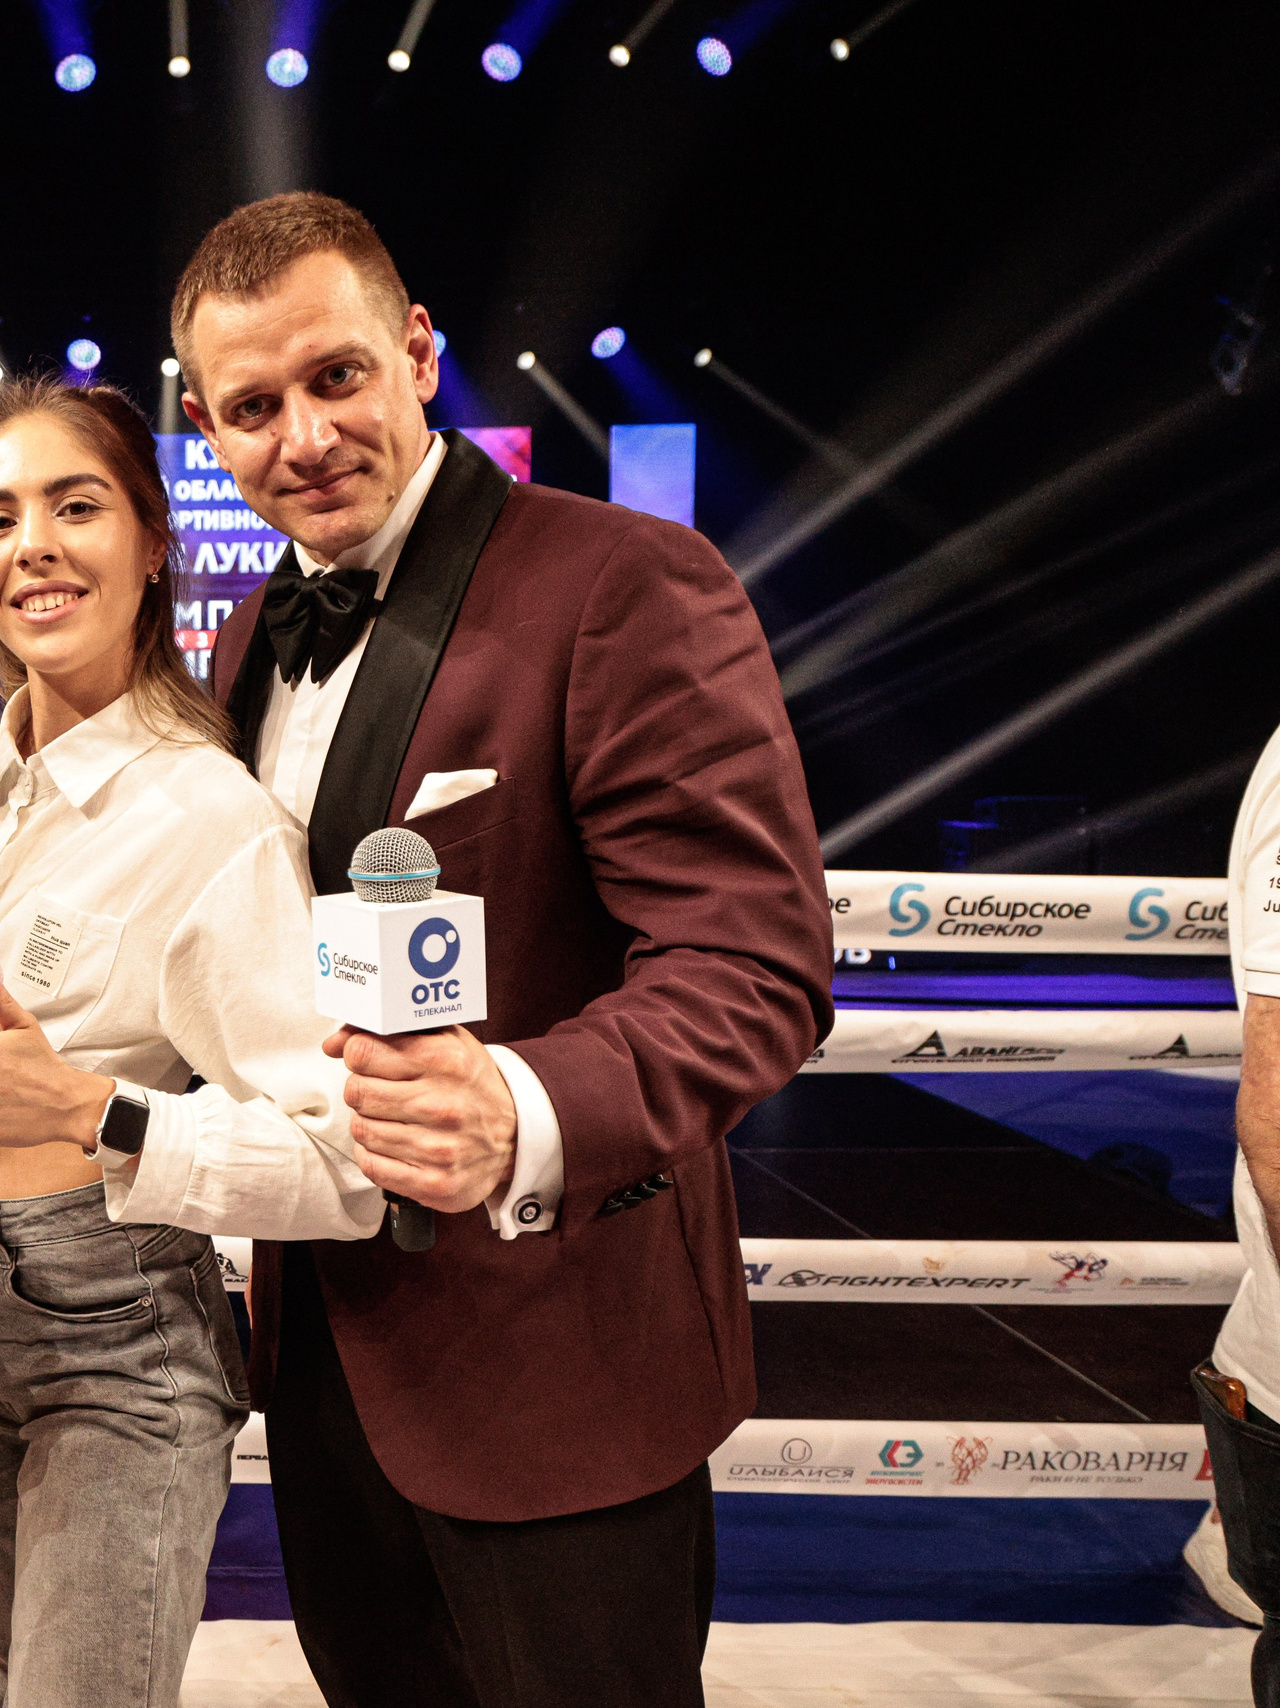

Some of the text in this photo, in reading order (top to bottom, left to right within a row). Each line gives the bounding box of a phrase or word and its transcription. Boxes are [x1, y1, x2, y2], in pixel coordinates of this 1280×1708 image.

[944, 895, 1092, 921] Сибирское
[937, 919, 1043, 938] Стекло
[333, 953, 378, 975] Сибирское
[334, 966, 366, 986] Стекло
[411, 979, 460, 1005] ОТС
[414, 1003, 462, 1018] ТЕЛЕКАНАЛ
[819, 1275, 1030, 1288] FIGHTEXPERT
[1000, 1450, 1189, 1472] РАКОВАРНЯ
